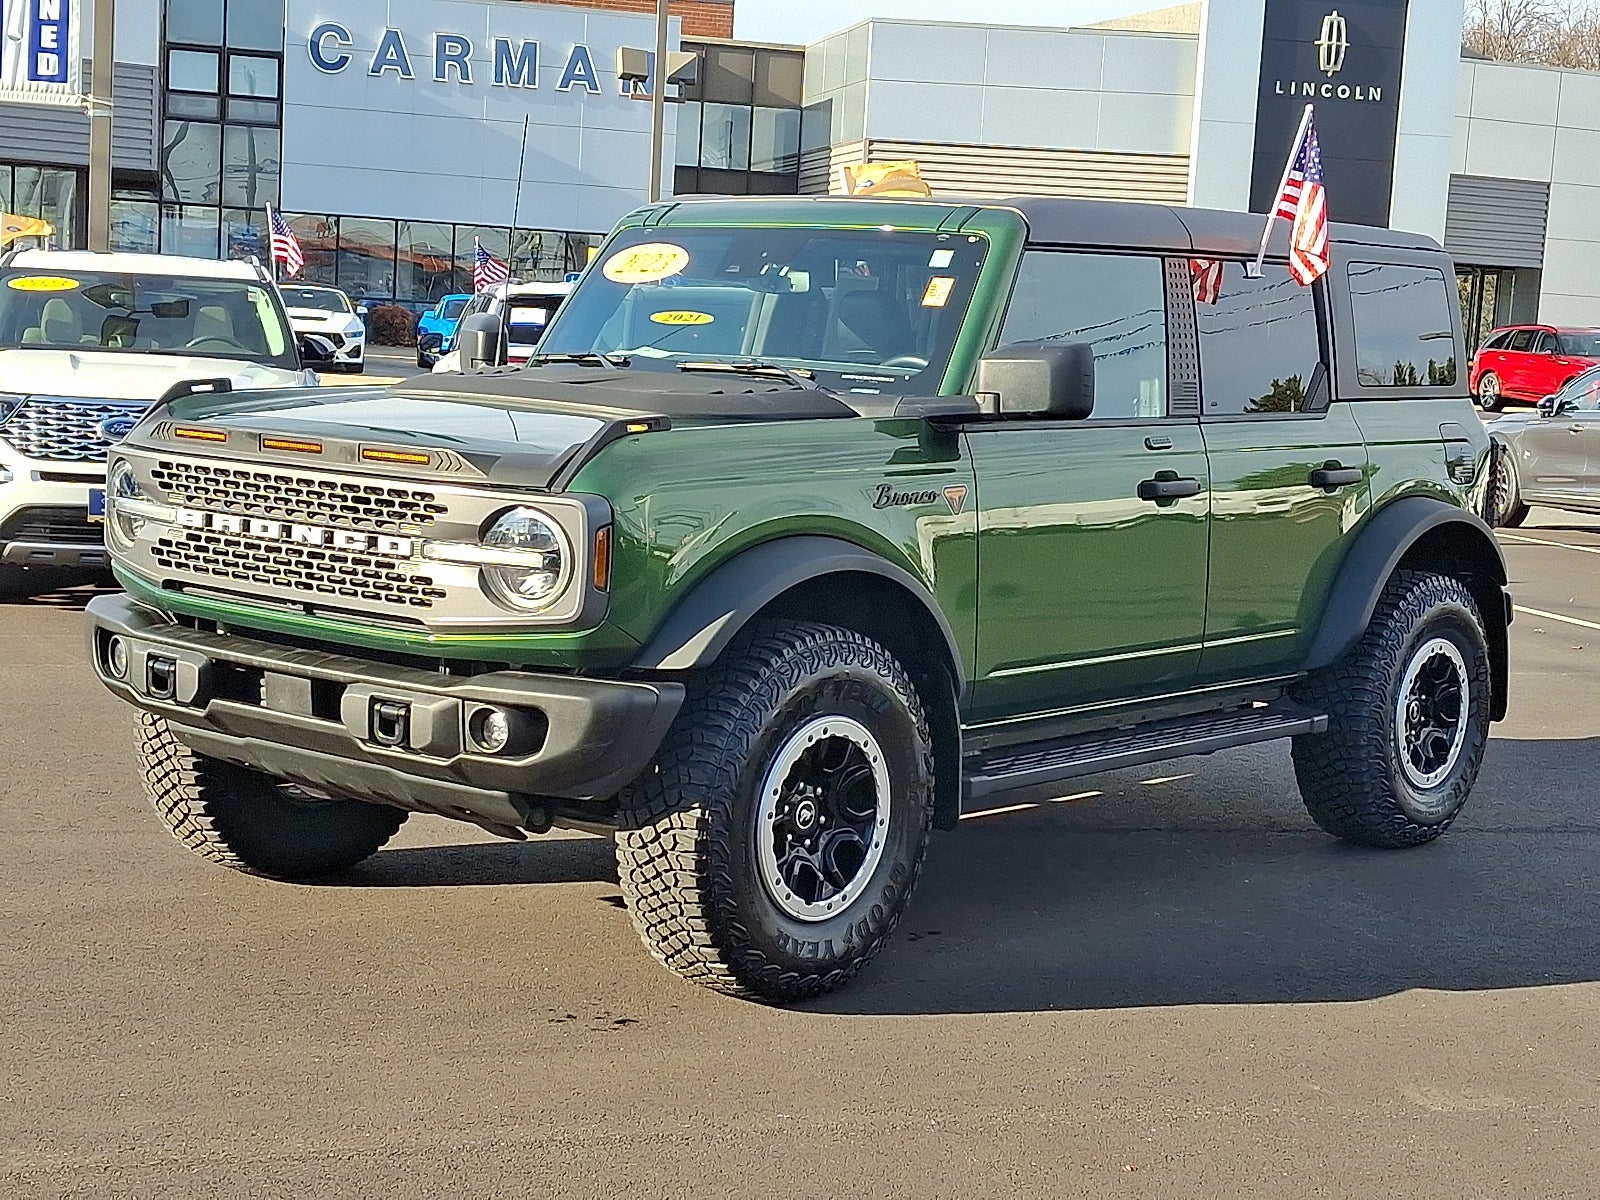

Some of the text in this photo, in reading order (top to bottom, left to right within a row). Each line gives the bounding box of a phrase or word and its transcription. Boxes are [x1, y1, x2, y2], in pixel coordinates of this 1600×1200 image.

[1275, 80, 1382, 101] LINCOLN
[872, 483, 940, 509] Bronco
[176, 511, 411, 558] BRONCO
